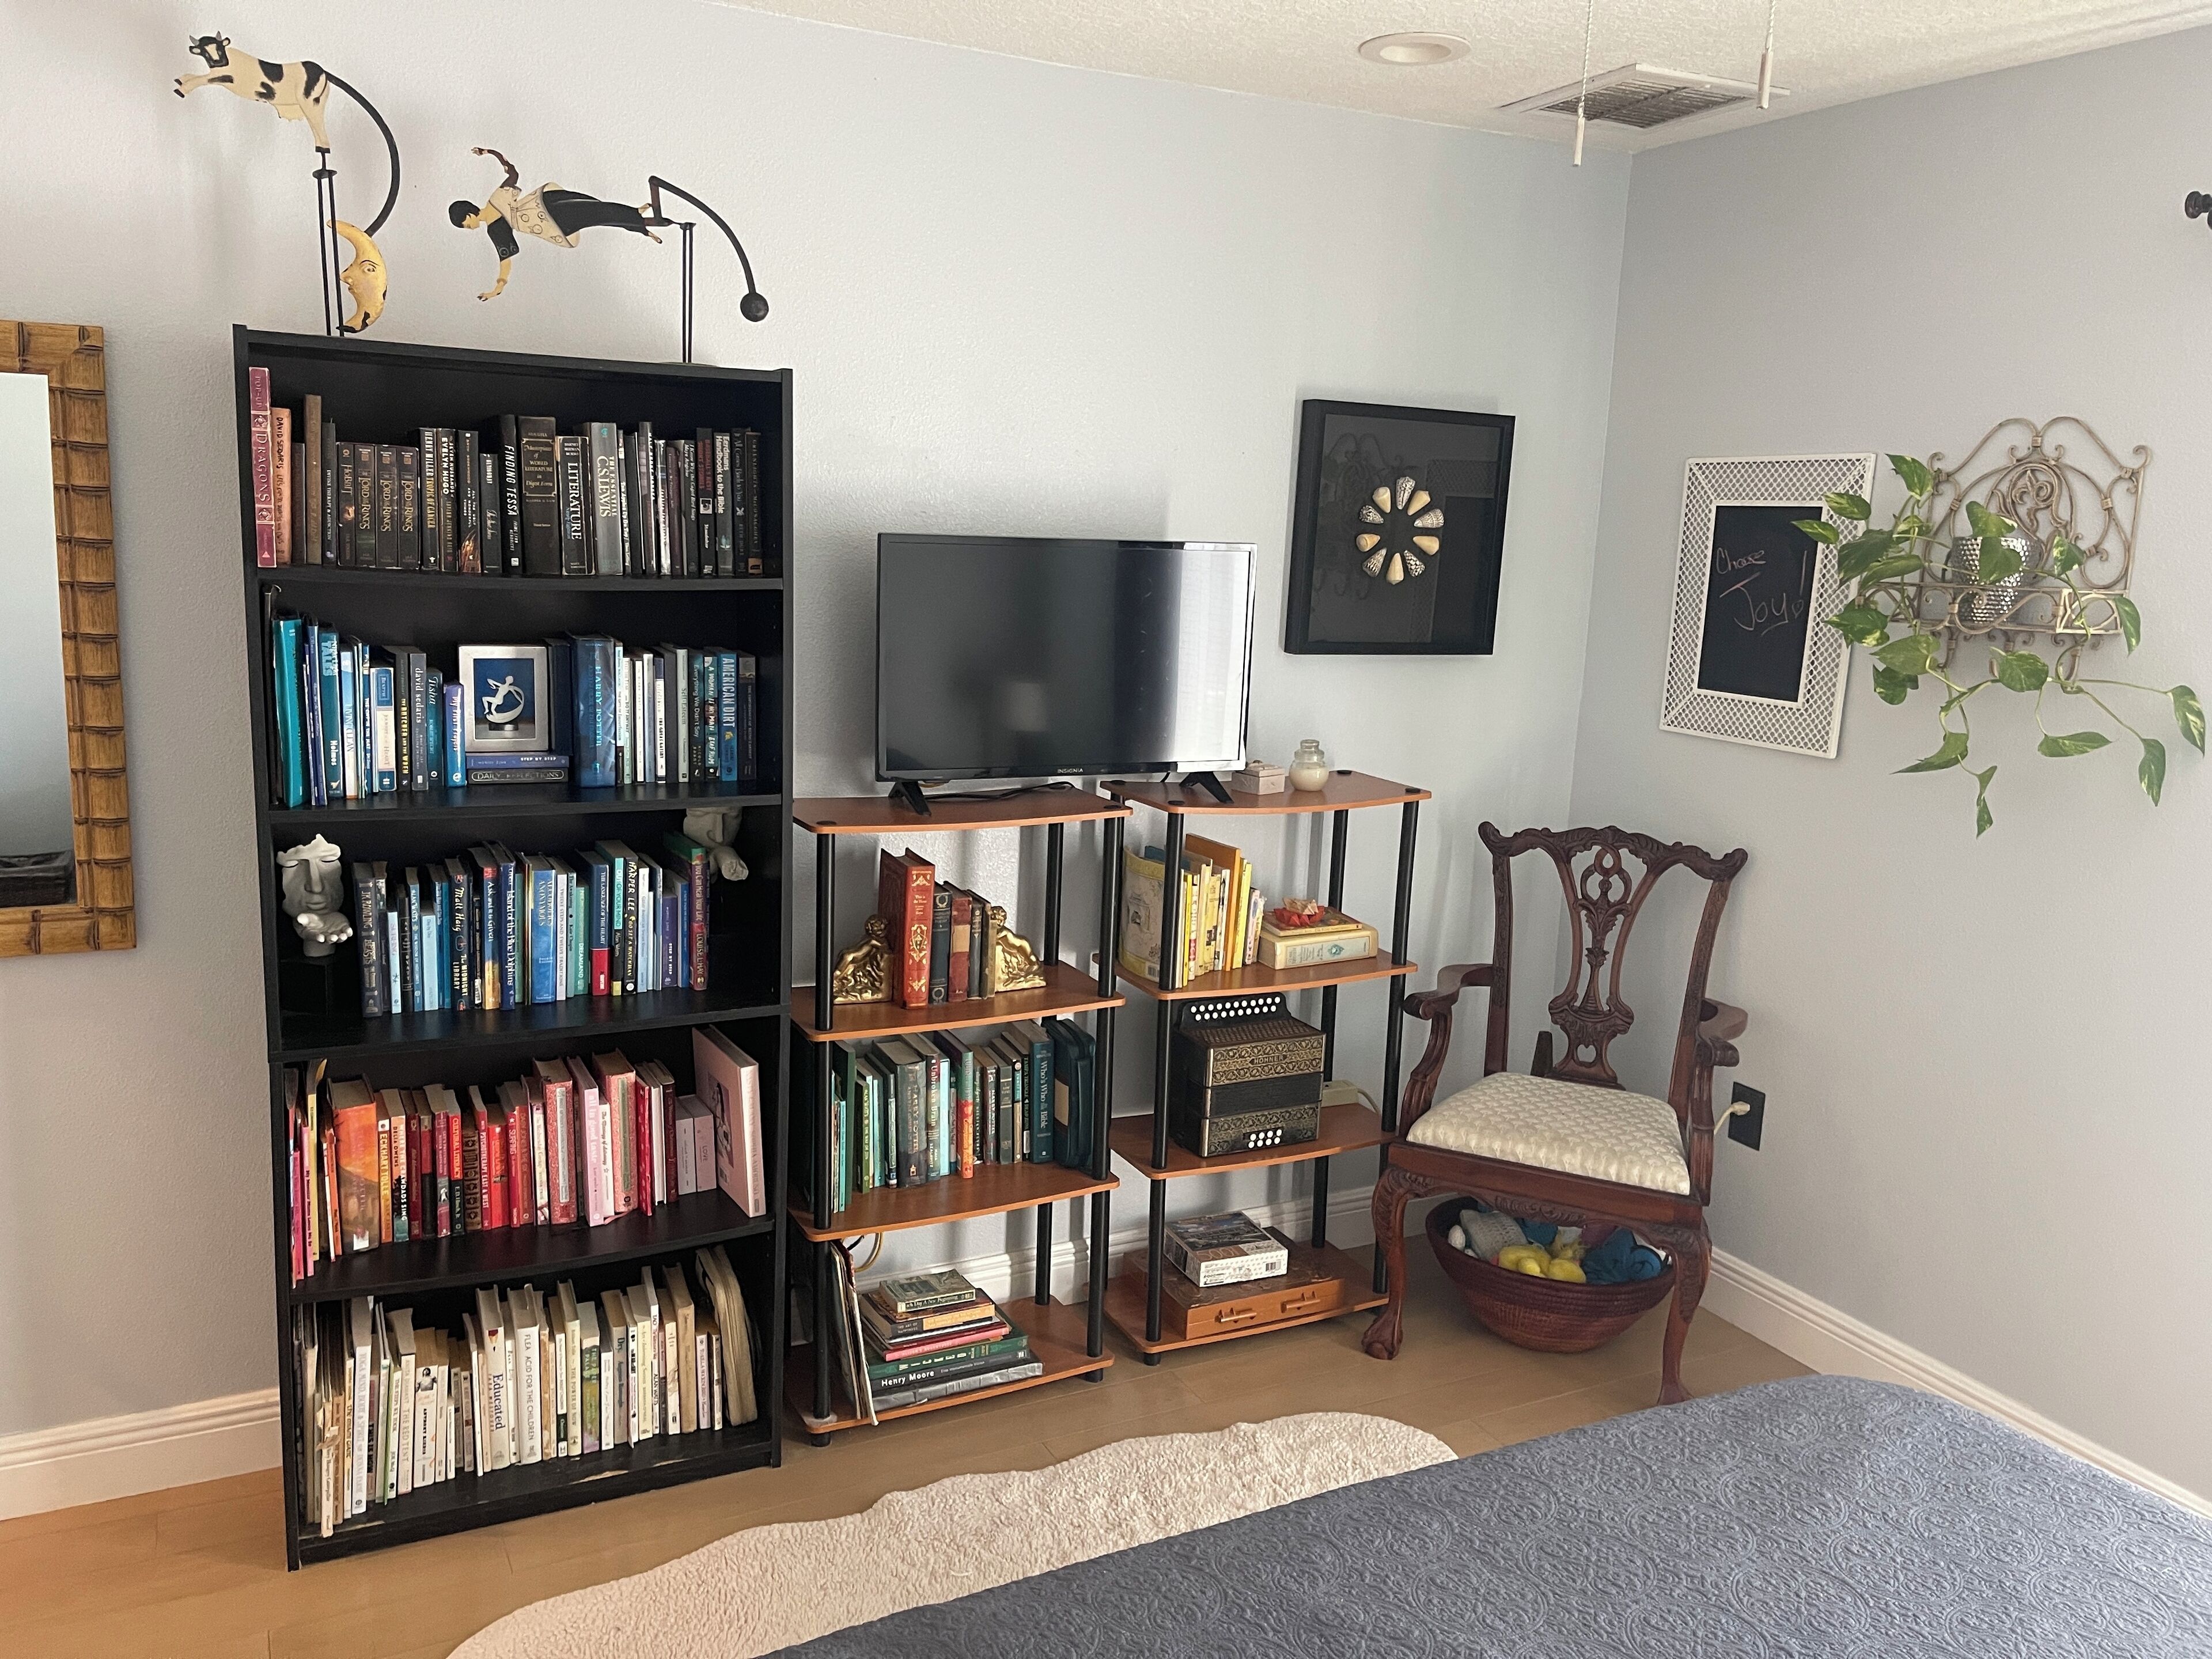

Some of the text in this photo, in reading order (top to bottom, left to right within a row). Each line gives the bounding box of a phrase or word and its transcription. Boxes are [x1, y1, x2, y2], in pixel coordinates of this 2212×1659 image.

[425, 431, 434, 451] HENRY
[255, 433, 270, 502] DRAGONS
[426, 453, 434, 476] MILLER
[504, 445, 517, 516] FINDING TESSA
[717, 474, 723, 482] to
[567, 462, 582, 540] LITERATURE
[598, 477, 611, 517] LEWIS
[359, 504, 370, 529] RINGS
[380, 506, 392, 532] RINGS
[402, 506, 414, 532] RINGS
[321, 642, 333, 676] TALES
[415, 668, 423, 691] david
[429, 676, 438, 706] Tisha
[694, 697, 699, 707] We
[722, 658, 735, 728] AMERICAN DIRT
[415, 694, 425, 724] sedaris
[627, 861, 637, 911] HARPER LEE
[695, 876, 703, 886] Can
[452, 887, 465, 932] Matt Haig
[507, 890, 515, 912] Island
[507, 913, 514, 921] of
[461, 965, 469, 997] MIDNIGHT
[505, 953, 515, 986] Dolphins
[1254, 1055, 1284, 1065] HOHNER
[1040, 1084, 1048, 1102] Who
[589, 1109, 596, 1118] in
[509, 1129, 517, 1155] SURFING
[587, 1120, 597, 1139] good
[380, 1134, 389, 1196] ECKHART TOLLE
[480, 1131, 488, 1173] PSYCHOTHERAPY
[881, 1370, 934, 1387] Henry Moore
[492, 1373, 506, 1430] Educated
[526, 1392, 534, 1403] THE
[527, 1405, 535, 1440] CHILDREN
